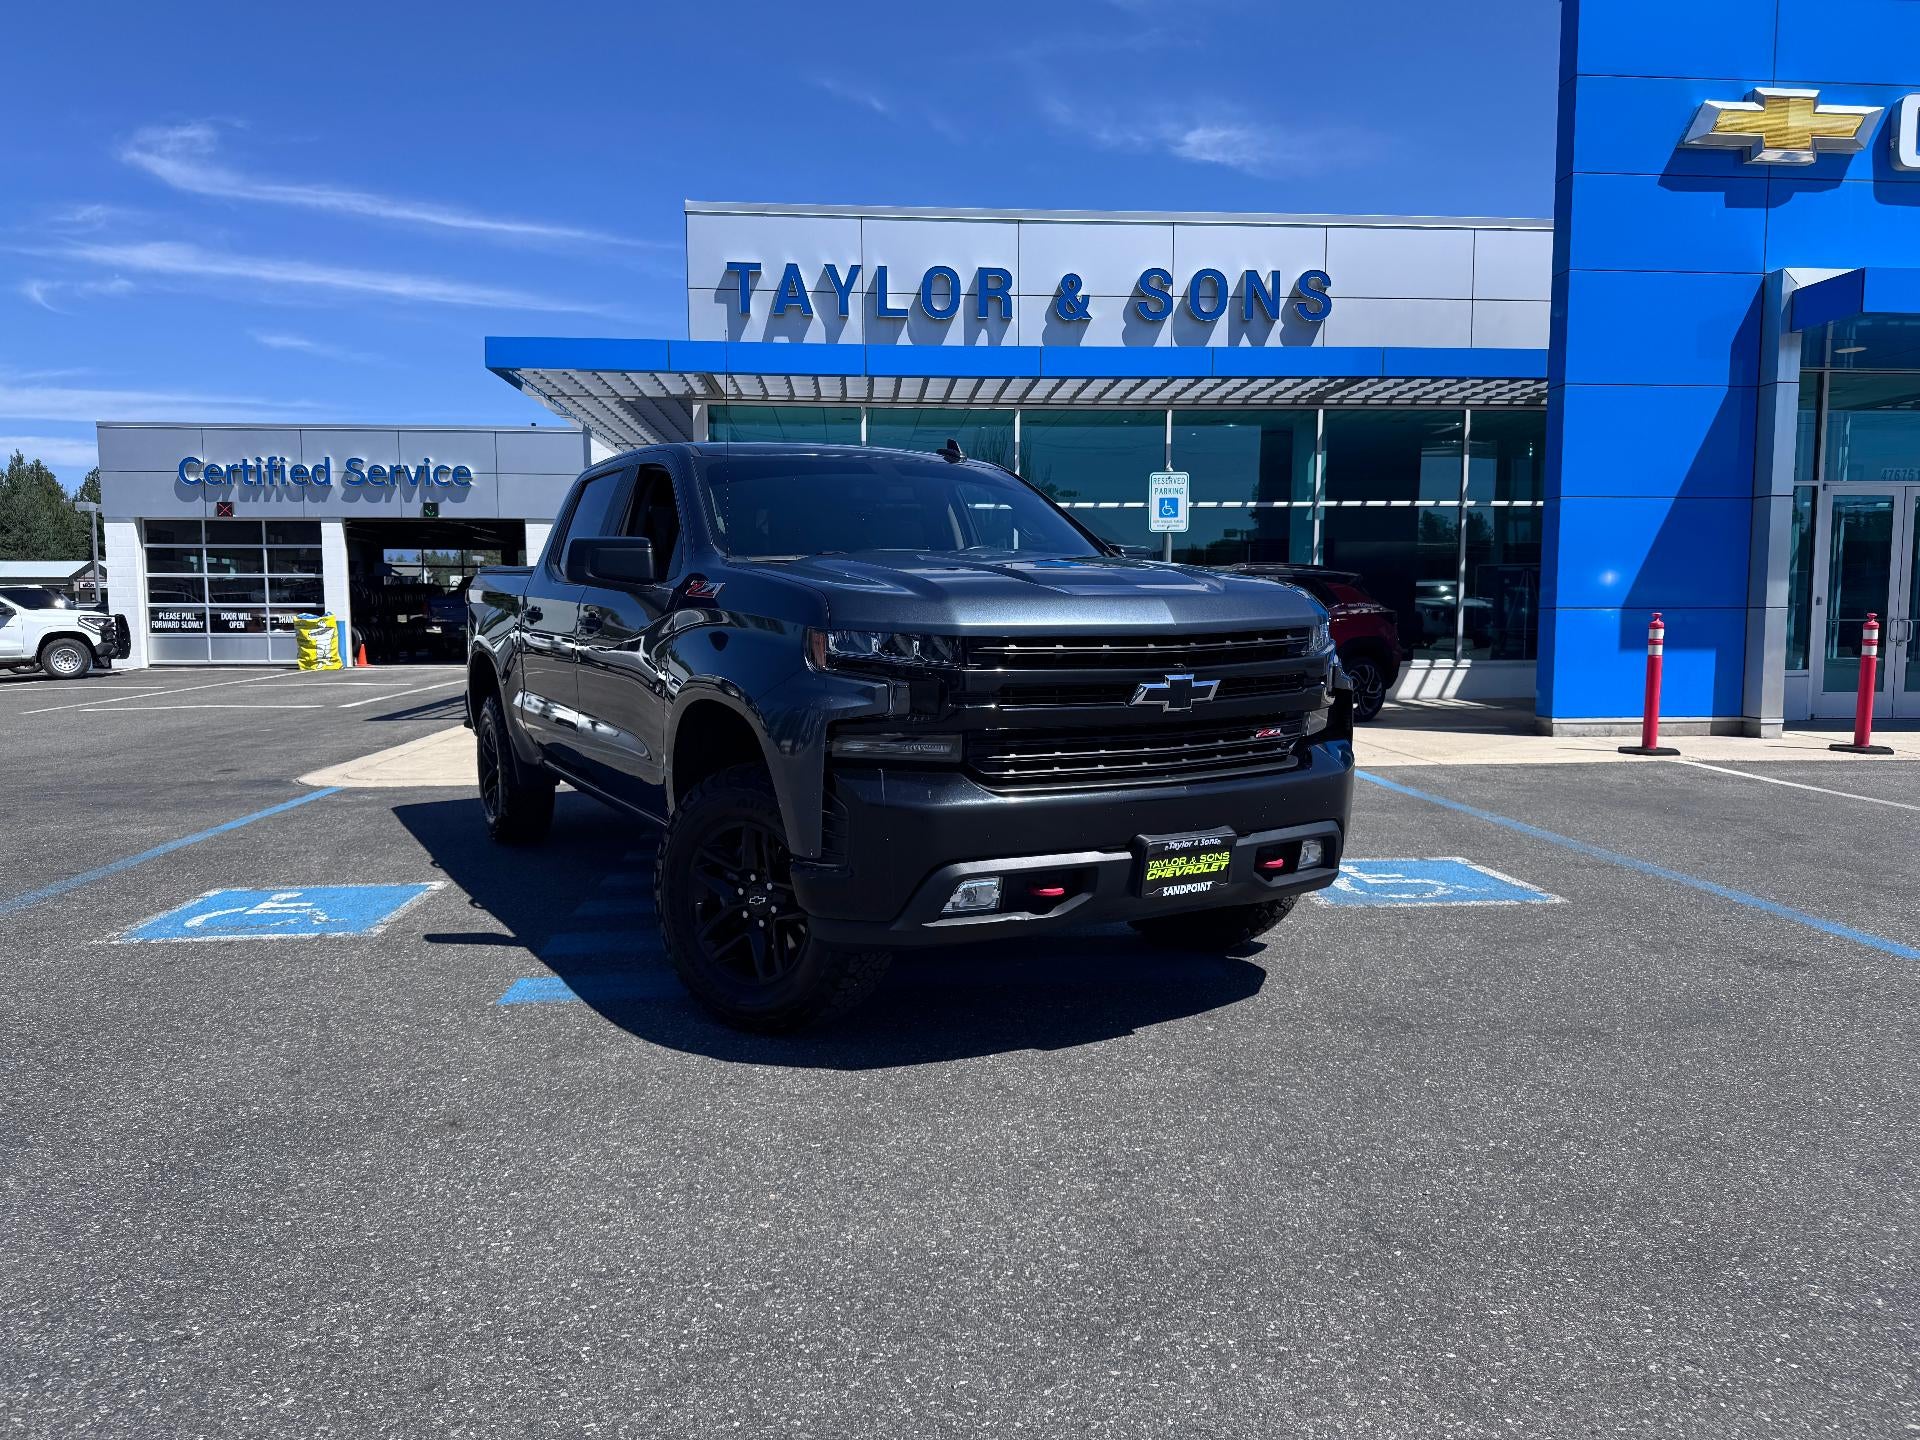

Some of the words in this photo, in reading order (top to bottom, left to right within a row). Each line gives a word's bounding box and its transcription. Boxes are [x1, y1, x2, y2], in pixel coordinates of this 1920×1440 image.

[727, 262, 1014, 321] TAYLOR
[1055, 272, 1093, 322] &
[1138, 267, 1333, 323] SONS
[178, 456, 331, 487] Certified
[345, 457, 472, 488] Service
[1153, 477, 1185, 485] RESERVED
[158, 612, 181, 620] PLEASE
[181, 612, 196, 620] PULL
[220, 612, 238, 620] DOOR
[238, 612, 252, 620] WILL
[278, 615, 294, 624] THAN
[151, 620, 180, 629] FORWARD
[181, 620, 203, 629] SLOWLY
[229, 620, 245, 629] OPEN
[1169, 840, 1193, 850] Taylor
[1200, 838, 1218, 846] Sons
[1148, 856, 1187, 869] TAYLOR
[1189, 856, 1197, 865] &
[1199, 851, 1230, 862] SONS
[1146, 861, 1230, 880] CHEVROLET
[1162, 881, 1213, 897] SANDPOINT
